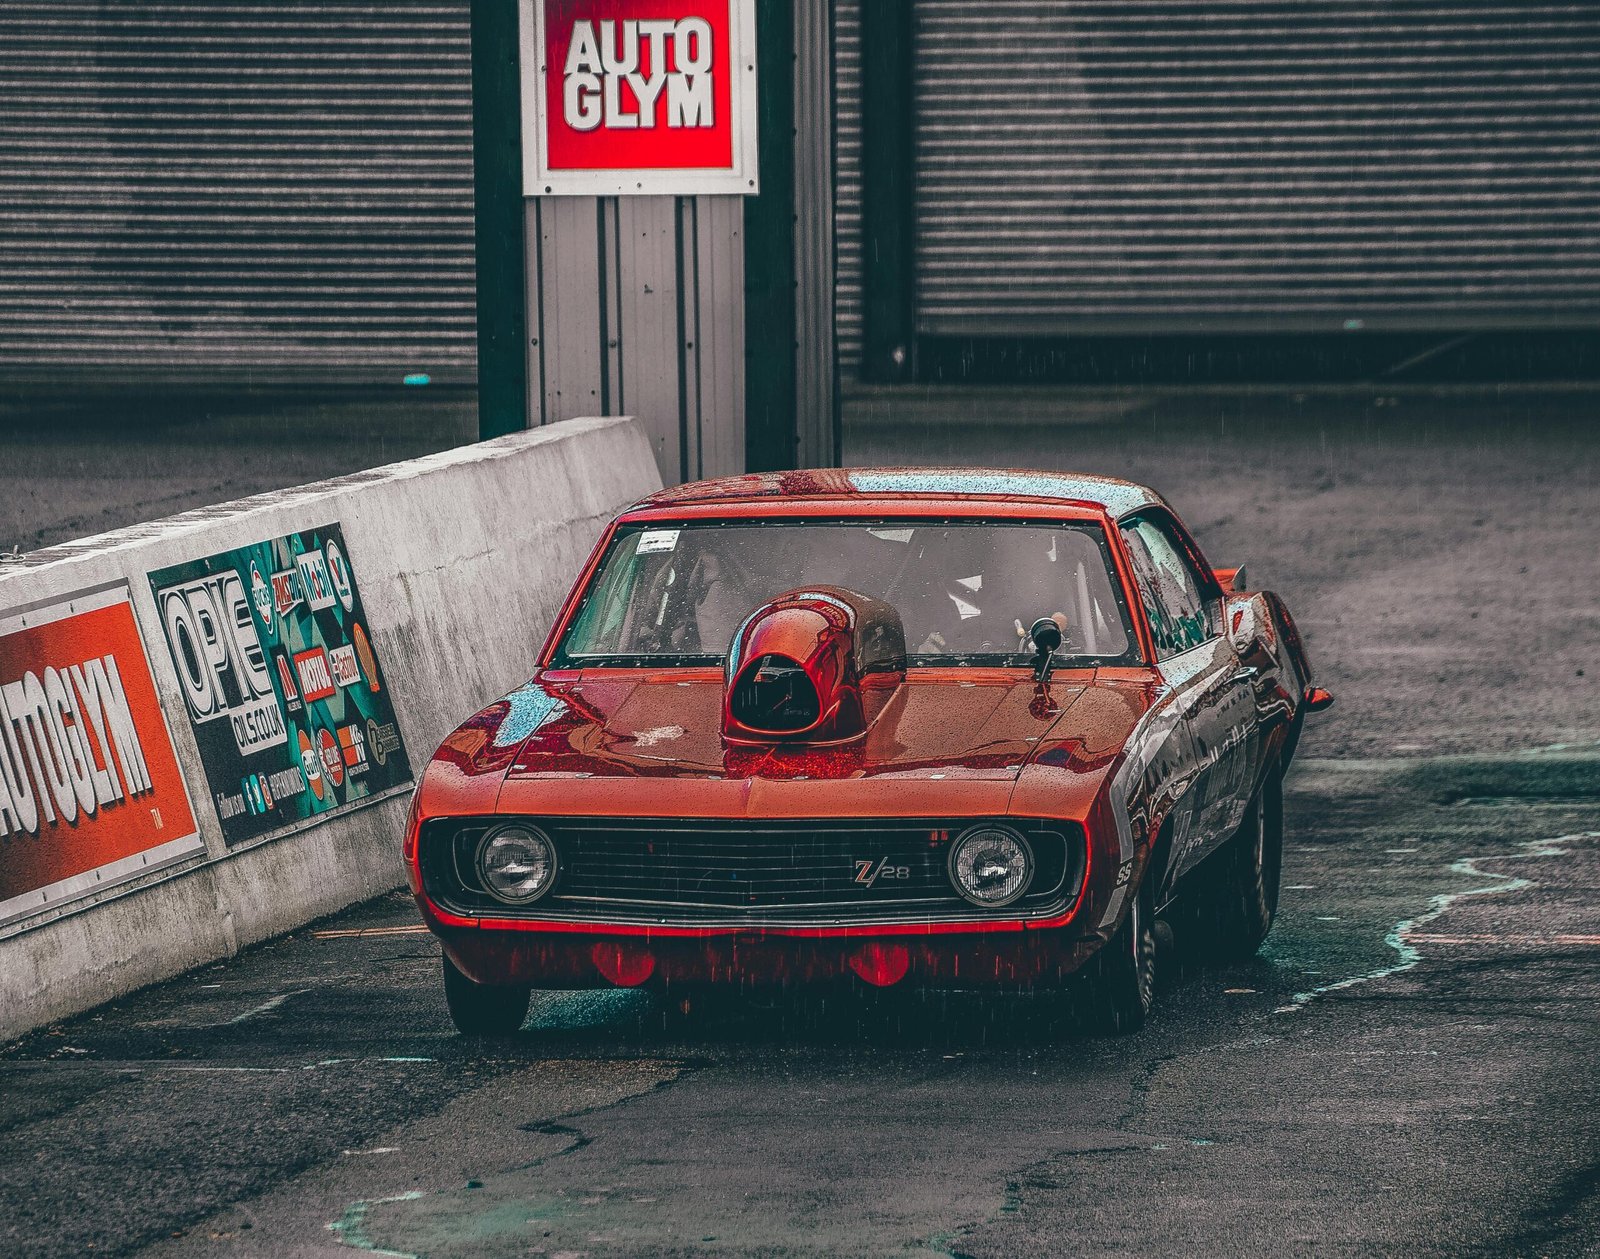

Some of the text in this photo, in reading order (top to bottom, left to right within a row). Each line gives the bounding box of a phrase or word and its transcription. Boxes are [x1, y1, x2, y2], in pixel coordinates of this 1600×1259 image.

[563, 16, 713, 75] AUTO
[563, 72, 714, 131] GLYM
[272, 572, 303, 609] AMSOIL
[300, 558, 333, 602] Mobil
[164, 576, 273, 715] OPIE
[335, 649, 359, 681] Castrol
[297, 655, 332, 695] MOTUL
[232, 704, 285, 748] OILS.CO.UK
[303, 754, 320, 776] Gulf
[855, 856, 910, 888] Z/28
[1116, 862, 1132, 885] SS
